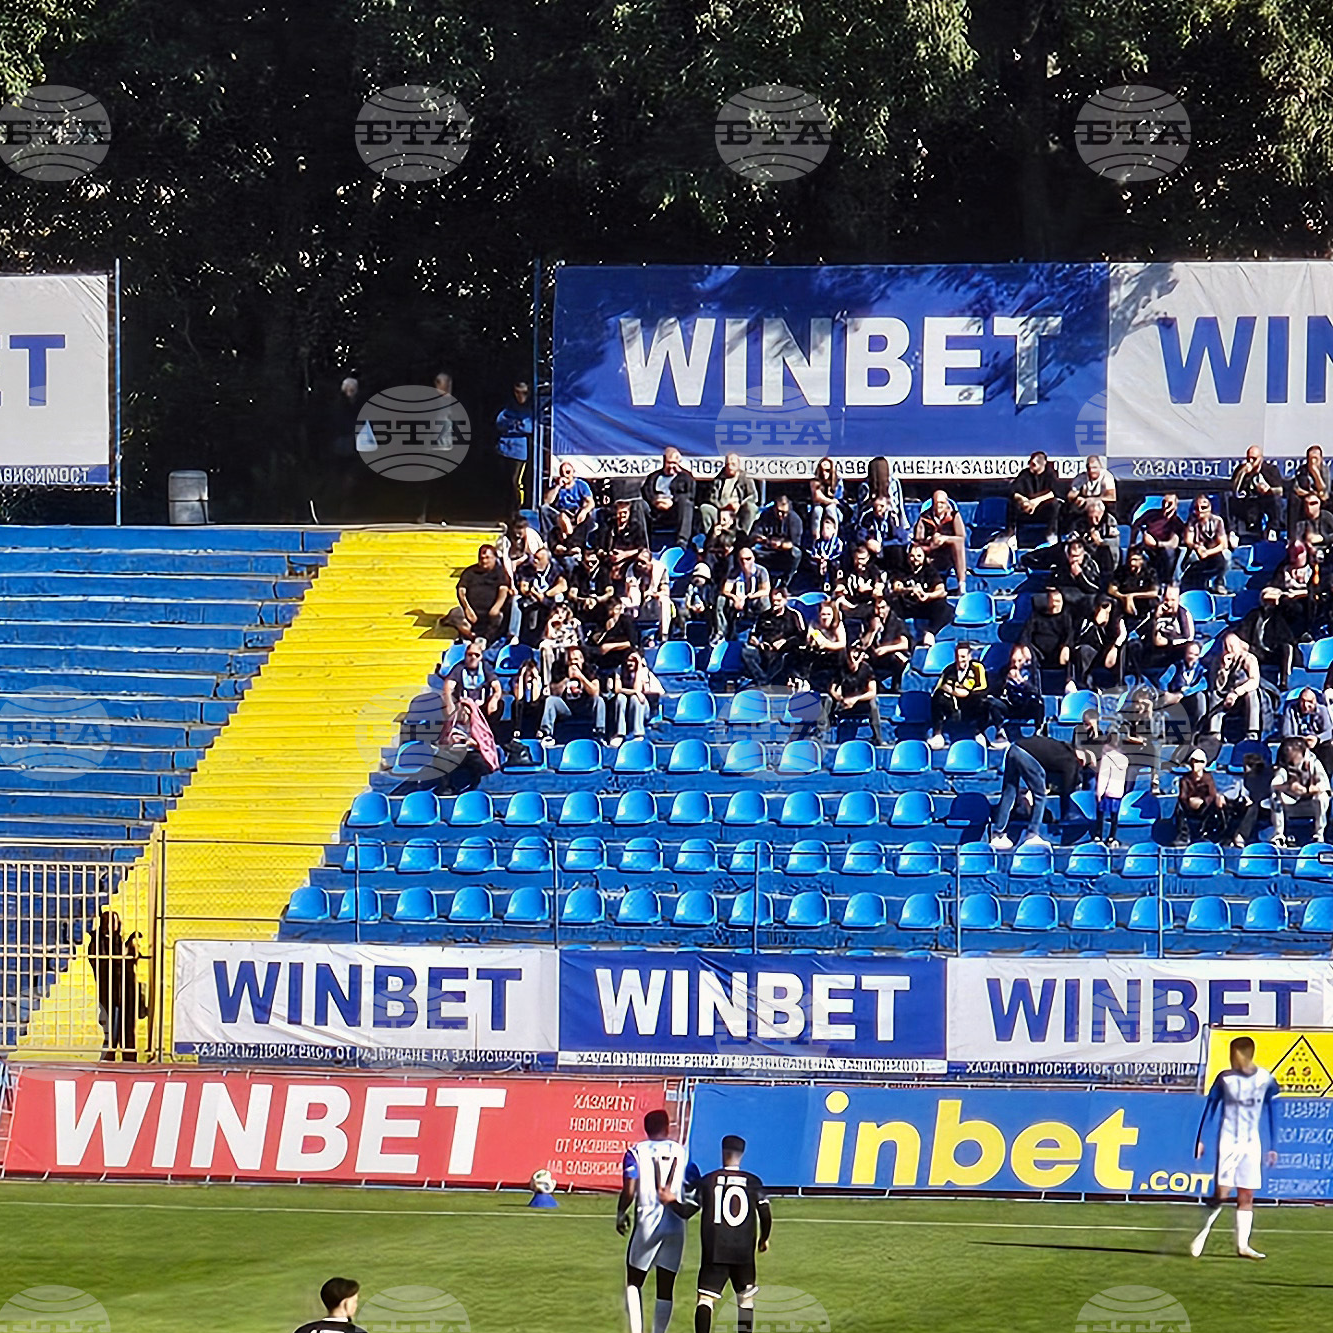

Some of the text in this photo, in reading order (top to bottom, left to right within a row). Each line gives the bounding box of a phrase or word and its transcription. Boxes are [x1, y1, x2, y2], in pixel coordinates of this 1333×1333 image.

[618, 315, 1066, 408] WINBET
[1132, 459, 1221, 477] ХАЗАРТЪТ
[211, 960, 523, 1034] WINBET
[594, 967, 912, 1042] WINBET
[985, 977, 1309, 1044] WINBET
[432, 1048, 449, 1063] НА
[53, 1079, 507, 1176] WINBET
[554, 1138, 571, 1153] ОТ
[714, 1184, 749, 1227] 10
